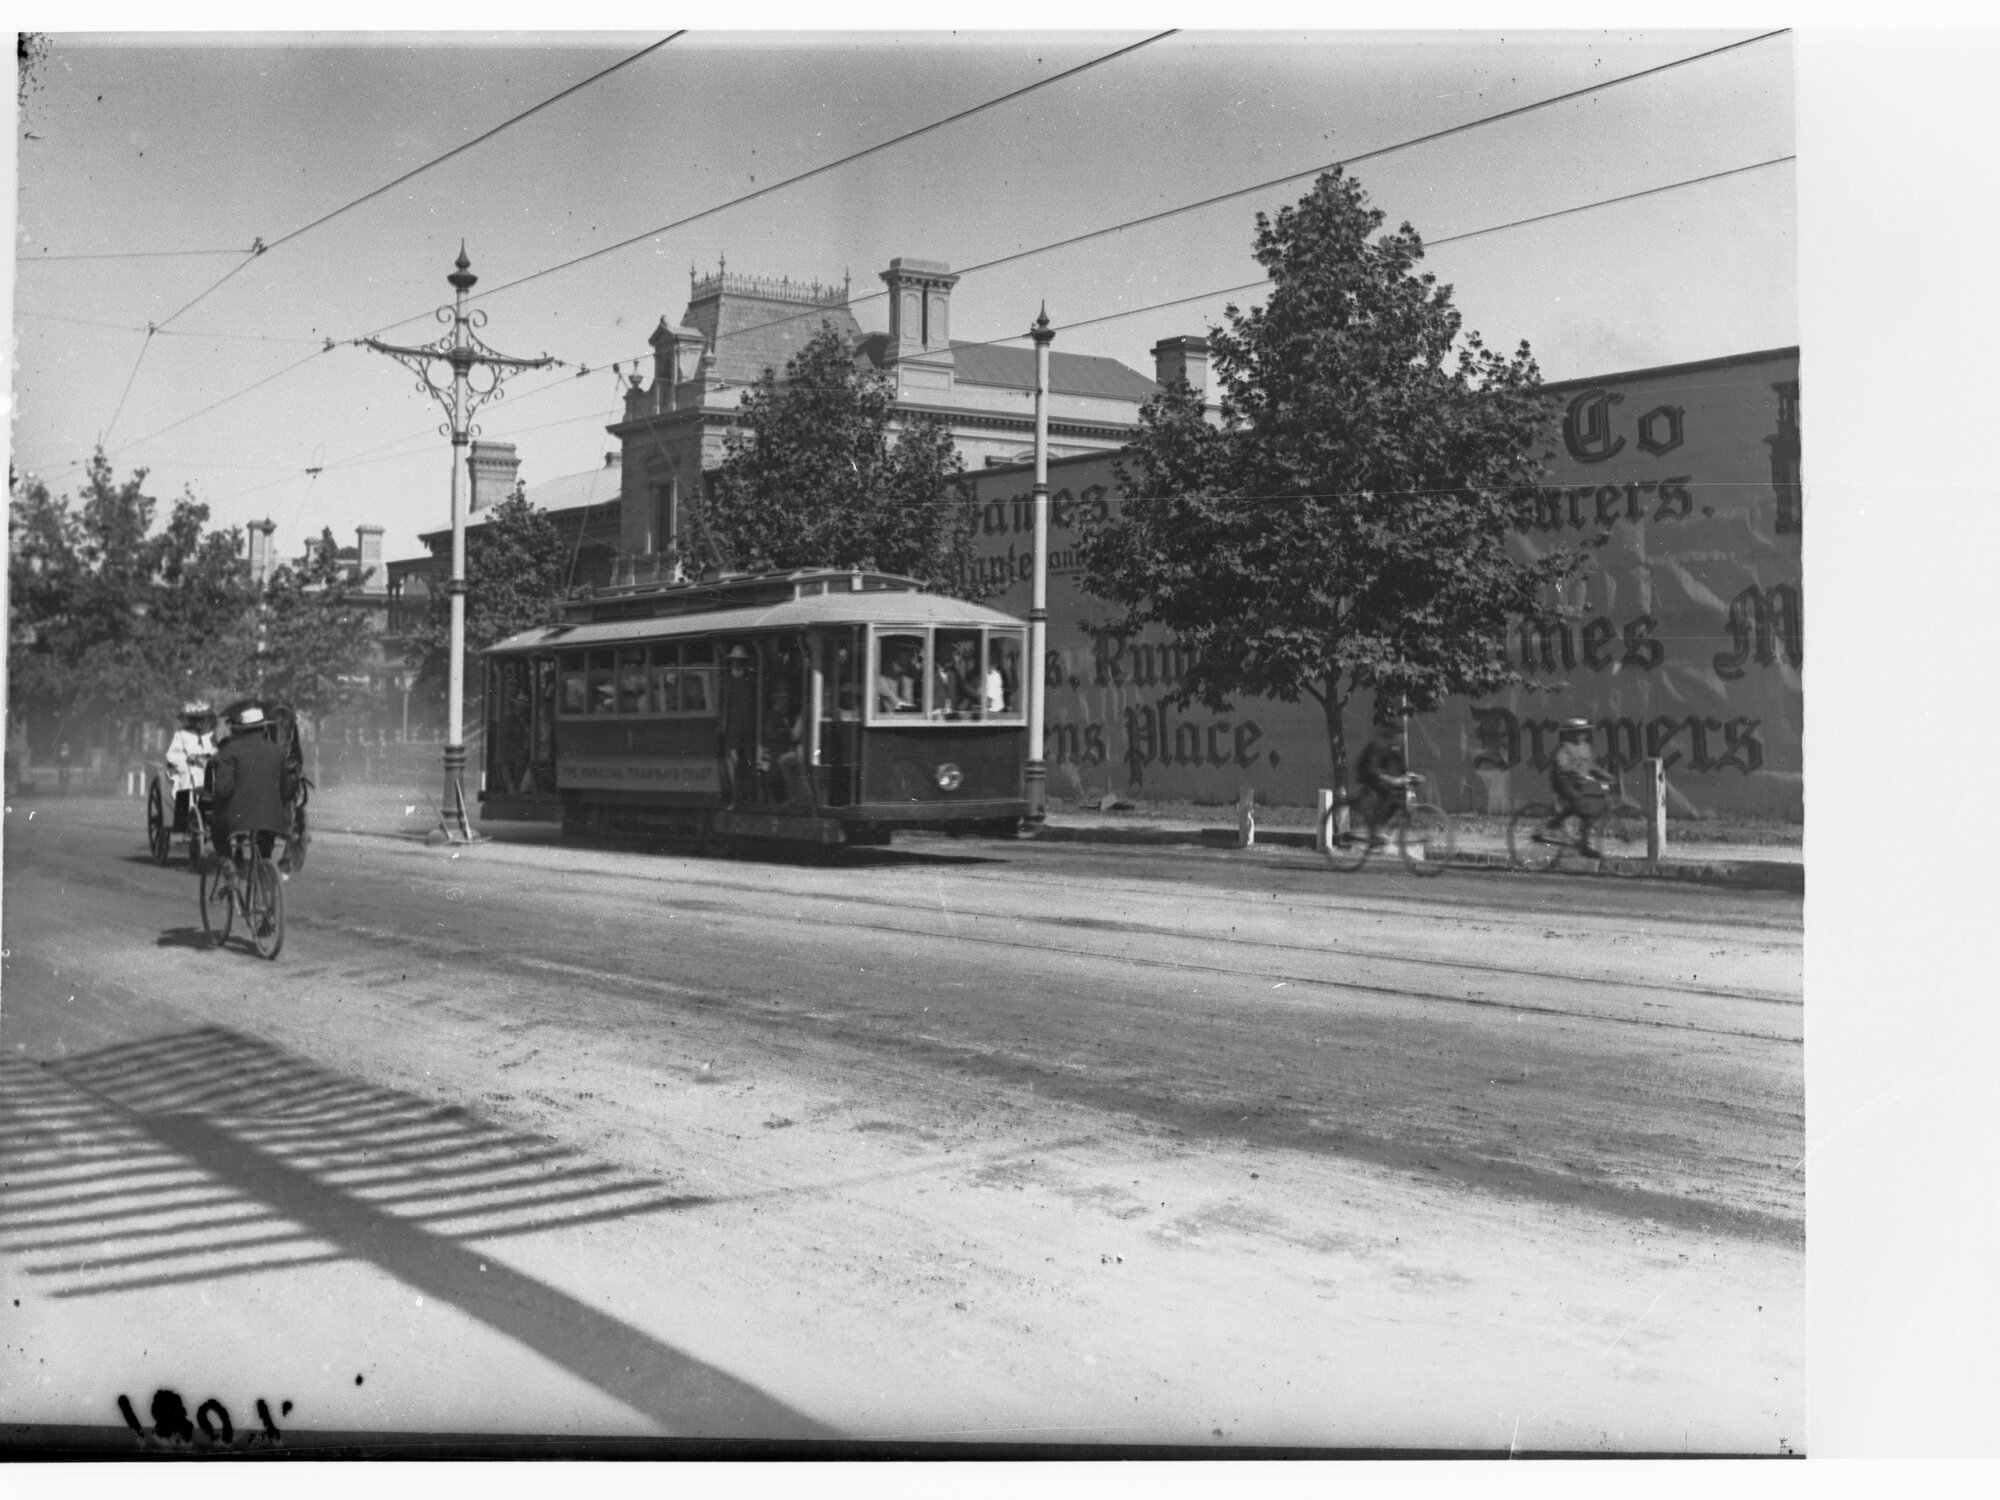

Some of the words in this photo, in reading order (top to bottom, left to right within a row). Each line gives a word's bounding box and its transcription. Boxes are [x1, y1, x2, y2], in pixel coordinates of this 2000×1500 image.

[1563, 388, 1685, 463] Co
[1125, 702, 1281, 787] Place.
[1470, 704, 1763, 780] Drpers
